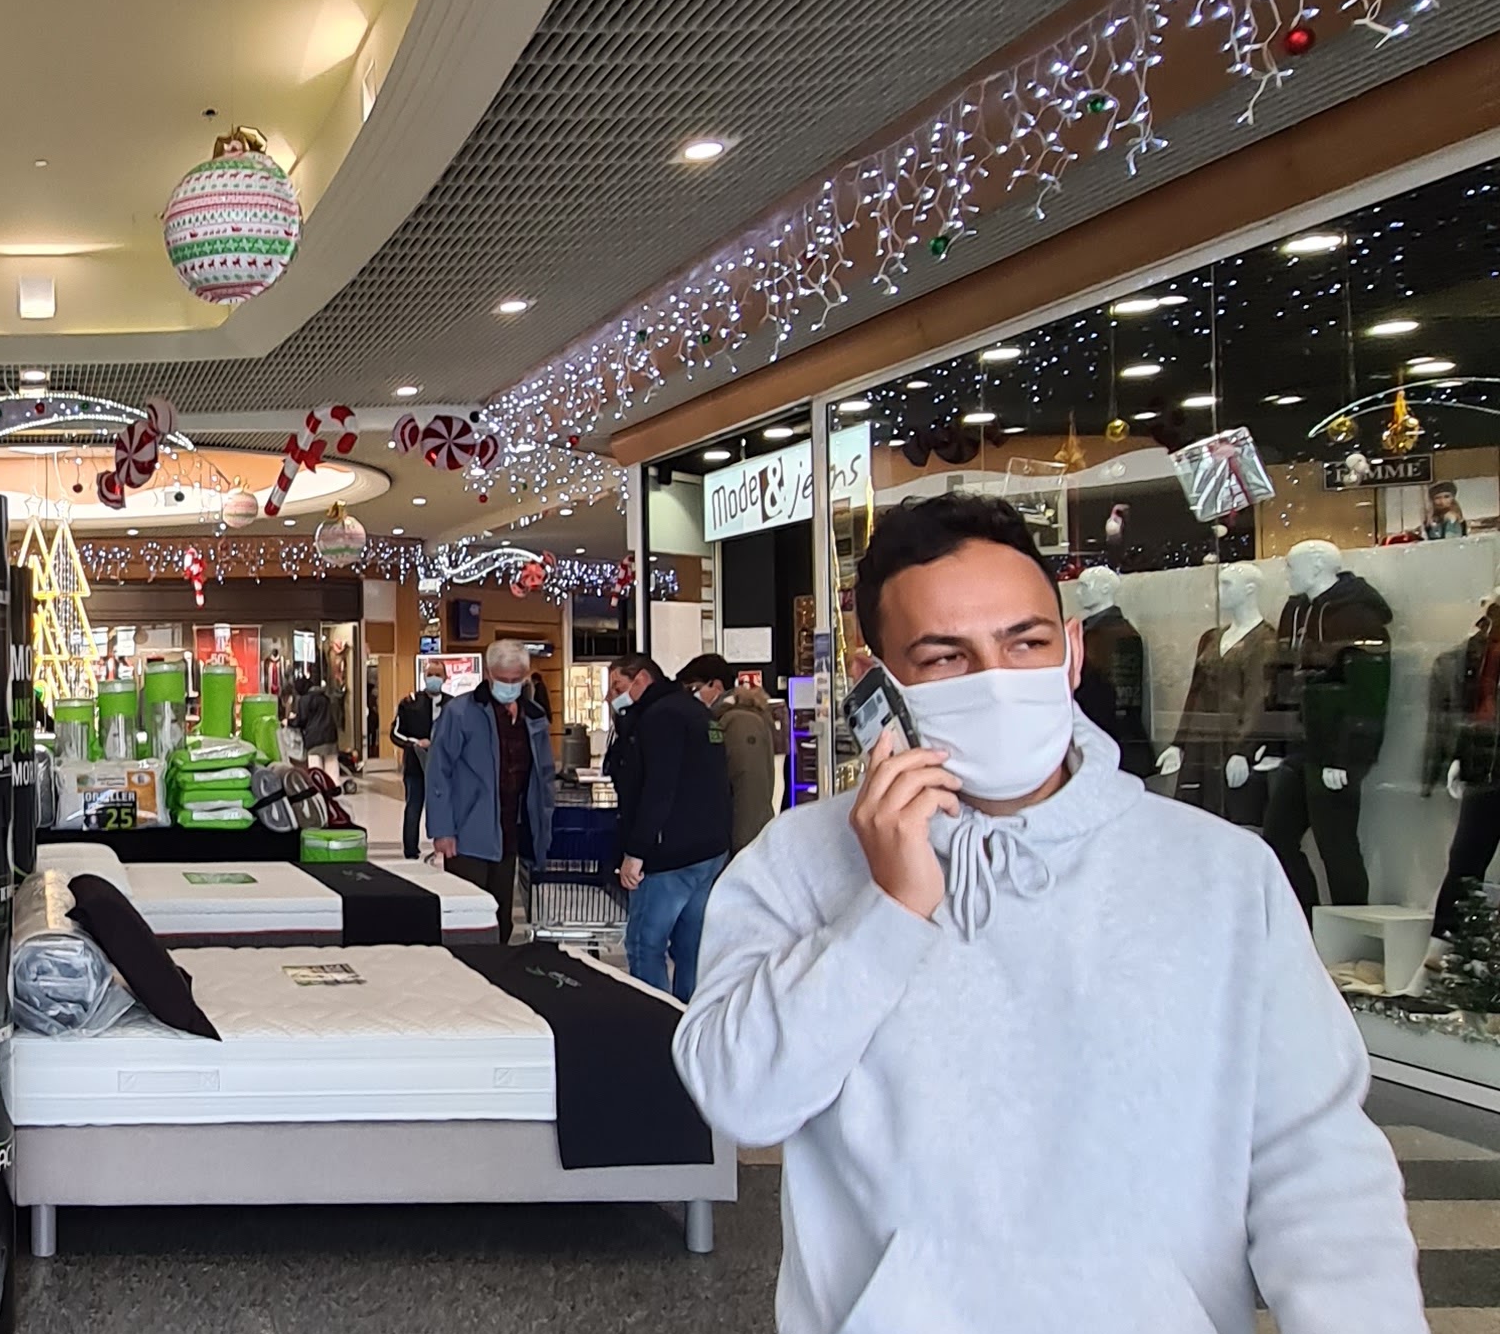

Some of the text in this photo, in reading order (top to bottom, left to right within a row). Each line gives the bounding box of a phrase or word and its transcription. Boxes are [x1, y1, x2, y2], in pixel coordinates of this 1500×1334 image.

[711, 454, 862, 531] Mode & jens
[1334, 462, 1422, 483] FMME
